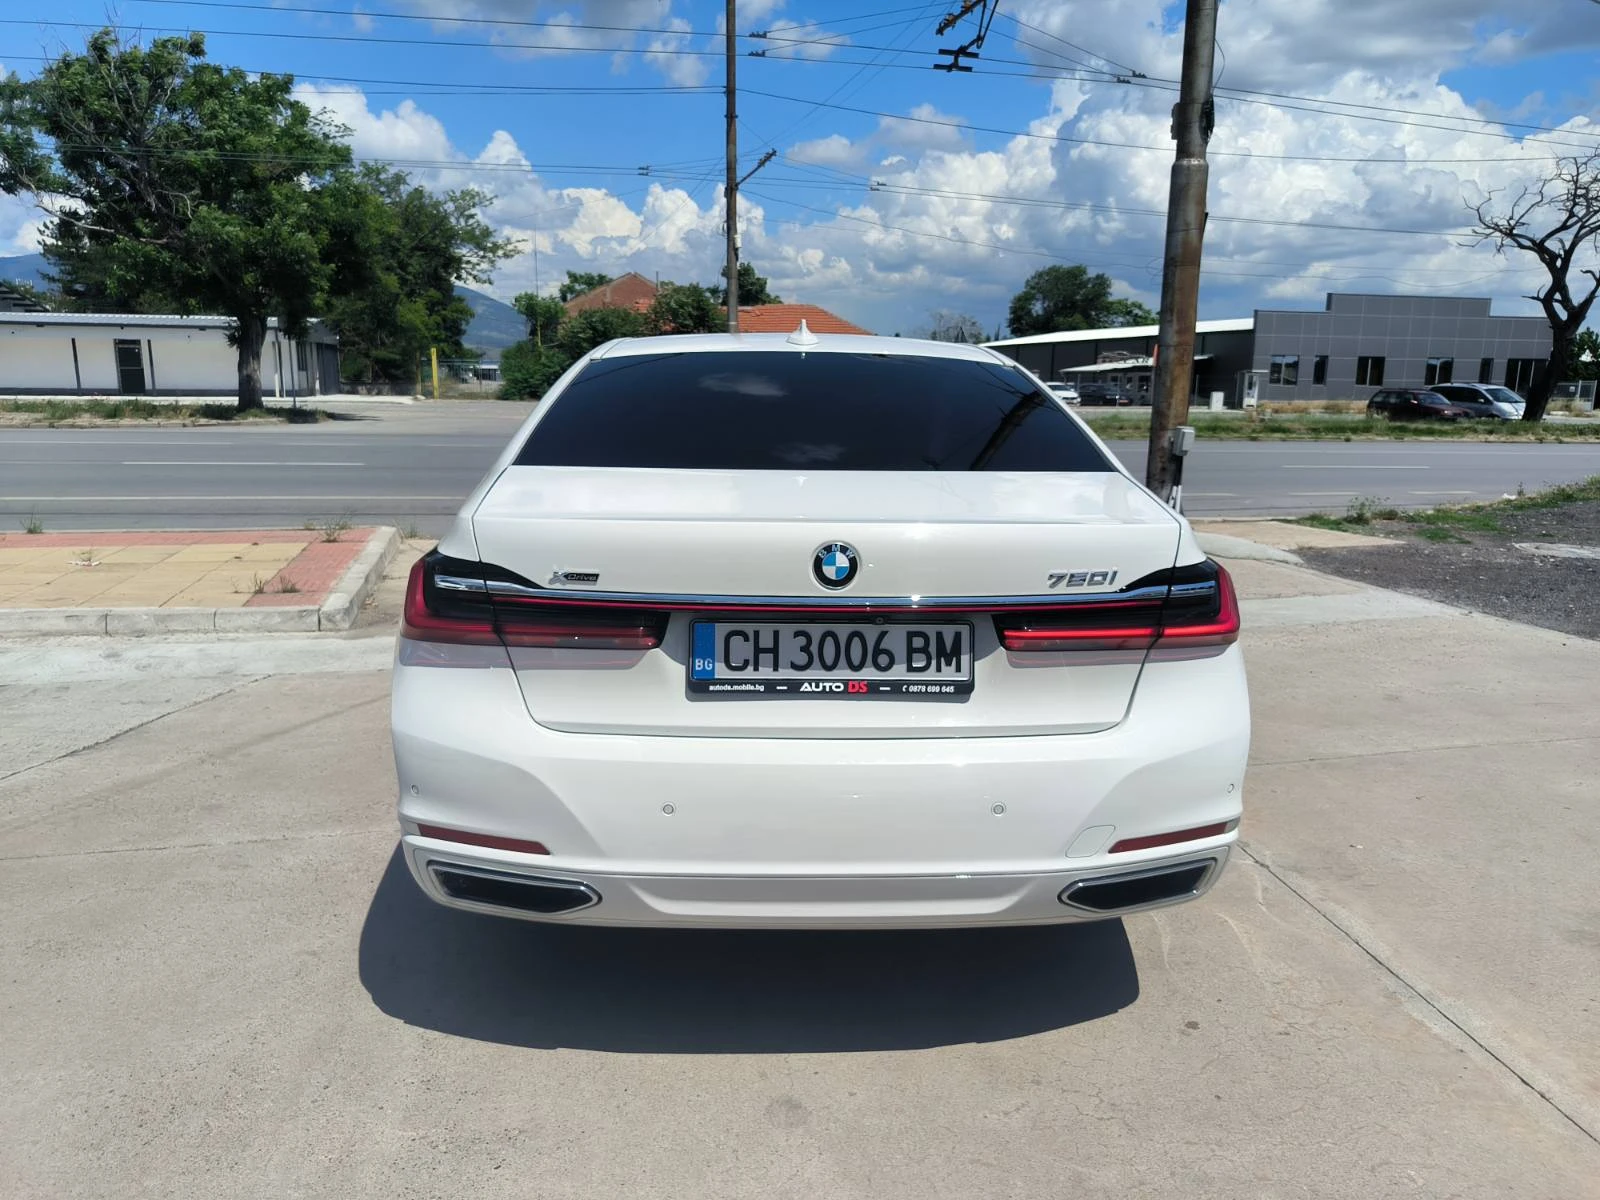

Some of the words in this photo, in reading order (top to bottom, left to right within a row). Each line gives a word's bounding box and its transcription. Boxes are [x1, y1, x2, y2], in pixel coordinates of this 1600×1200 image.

[818, 543, 855, 559] BMW
[724, 629, 780, 672] CH
[790, 630, 896, 673] 3006
[906, 630, 962, 673] BM
[695, 658, 713, 670] BG
[800, 682, 843, 692] AUTO
[847, 681, 868, 693] DS
